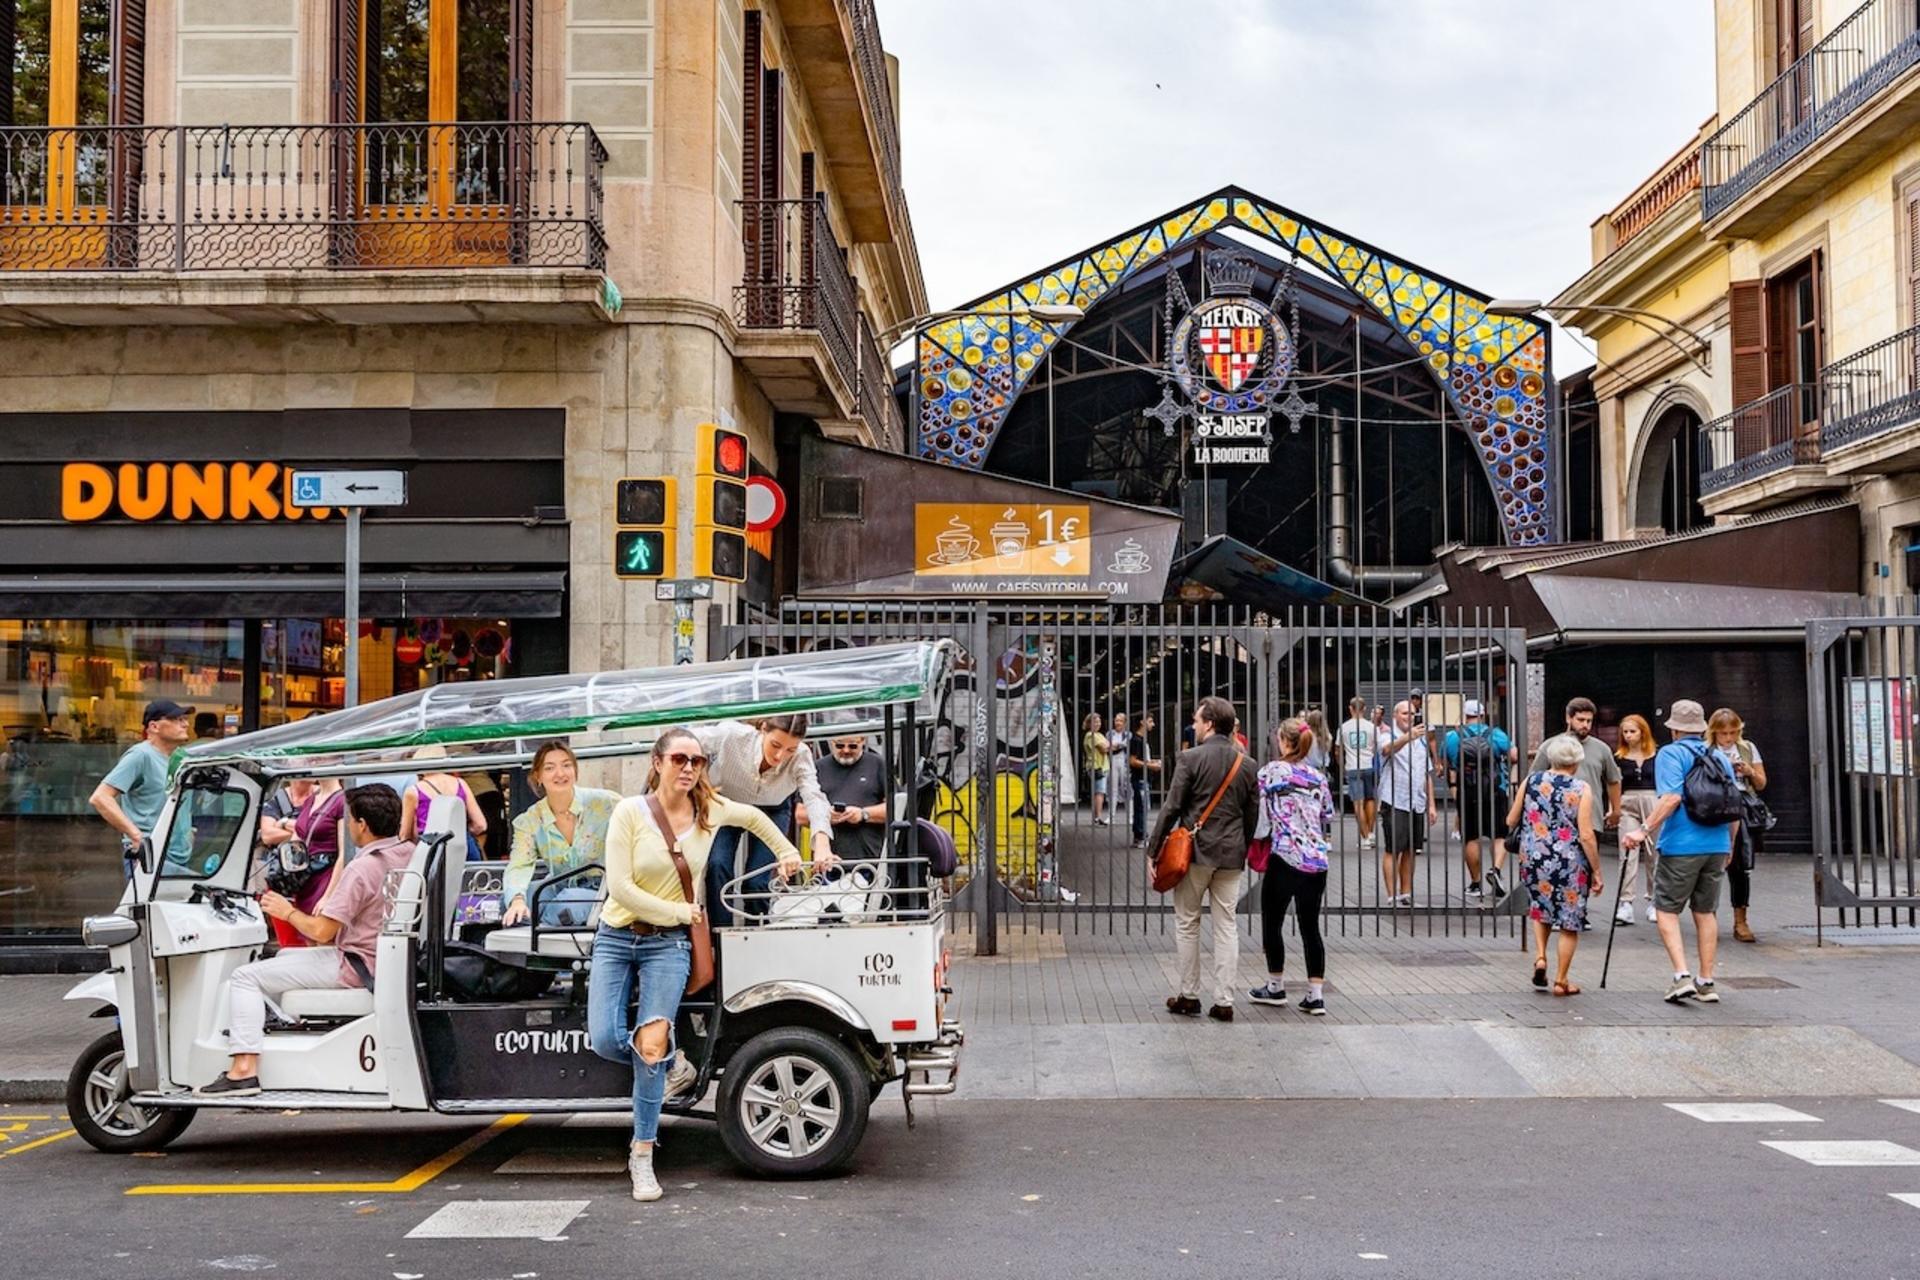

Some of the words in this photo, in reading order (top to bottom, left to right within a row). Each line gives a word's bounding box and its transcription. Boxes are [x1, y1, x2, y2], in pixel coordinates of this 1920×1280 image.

[1201, 304, 1263, 328] MERCAT
[1213, 415, 1267, 437] JOSEP
[1194, 446, 1211, 464] LA
[1212, 446, 1270, 464] BOQUERIA
[61, 461, 348, 522] DUNKI
[864, 952, 895, 973] ECO
[858, 973, 902, 988] TUKTUK
[359, 1034, 376, 1073] 6
